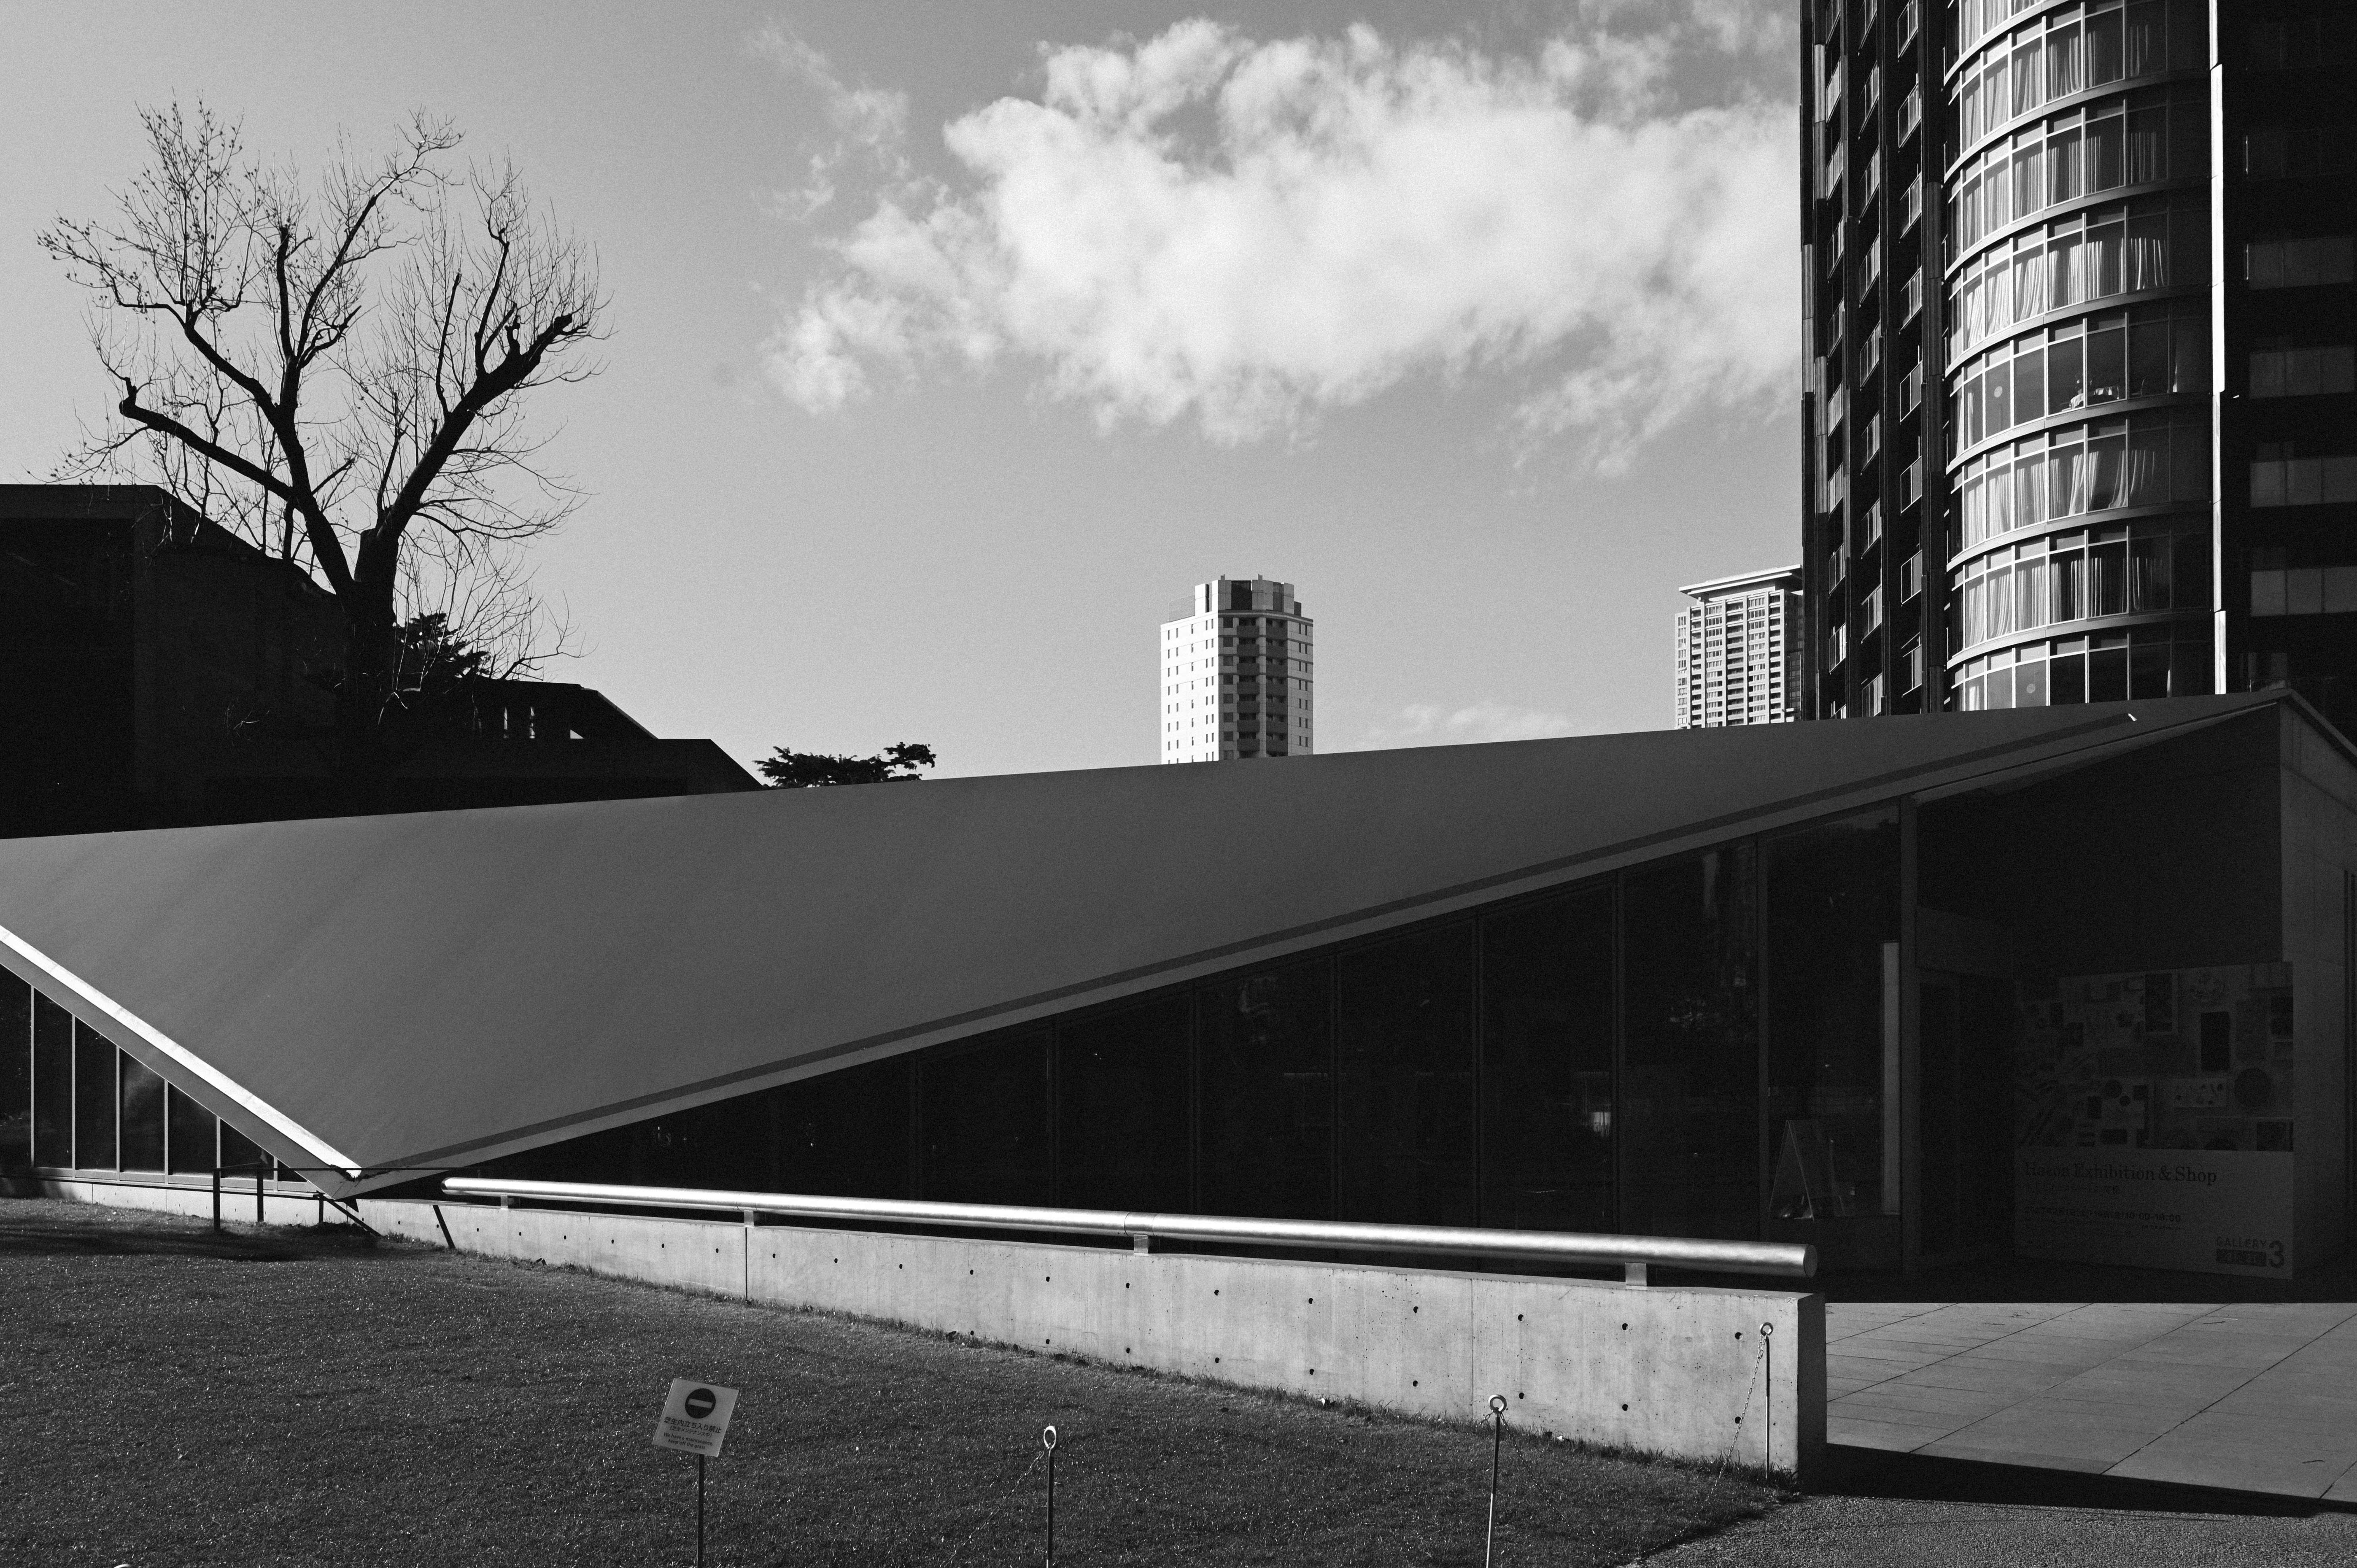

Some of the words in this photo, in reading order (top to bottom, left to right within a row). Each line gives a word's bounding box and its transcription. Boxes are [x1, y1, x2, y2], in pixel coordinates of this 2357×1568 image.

[2073, 1163, 2155, 1180] Exhibition
[2158, 1166, 2171, 1181] &
[2175, 1166, 2217, 1185] Shop
[2216, 1236, 2266, 1249] GALLERY
[2268, 1240, 2284, 1268] 3
[664, 1417, 722, 1433] 芝生内立ち入り禁止
